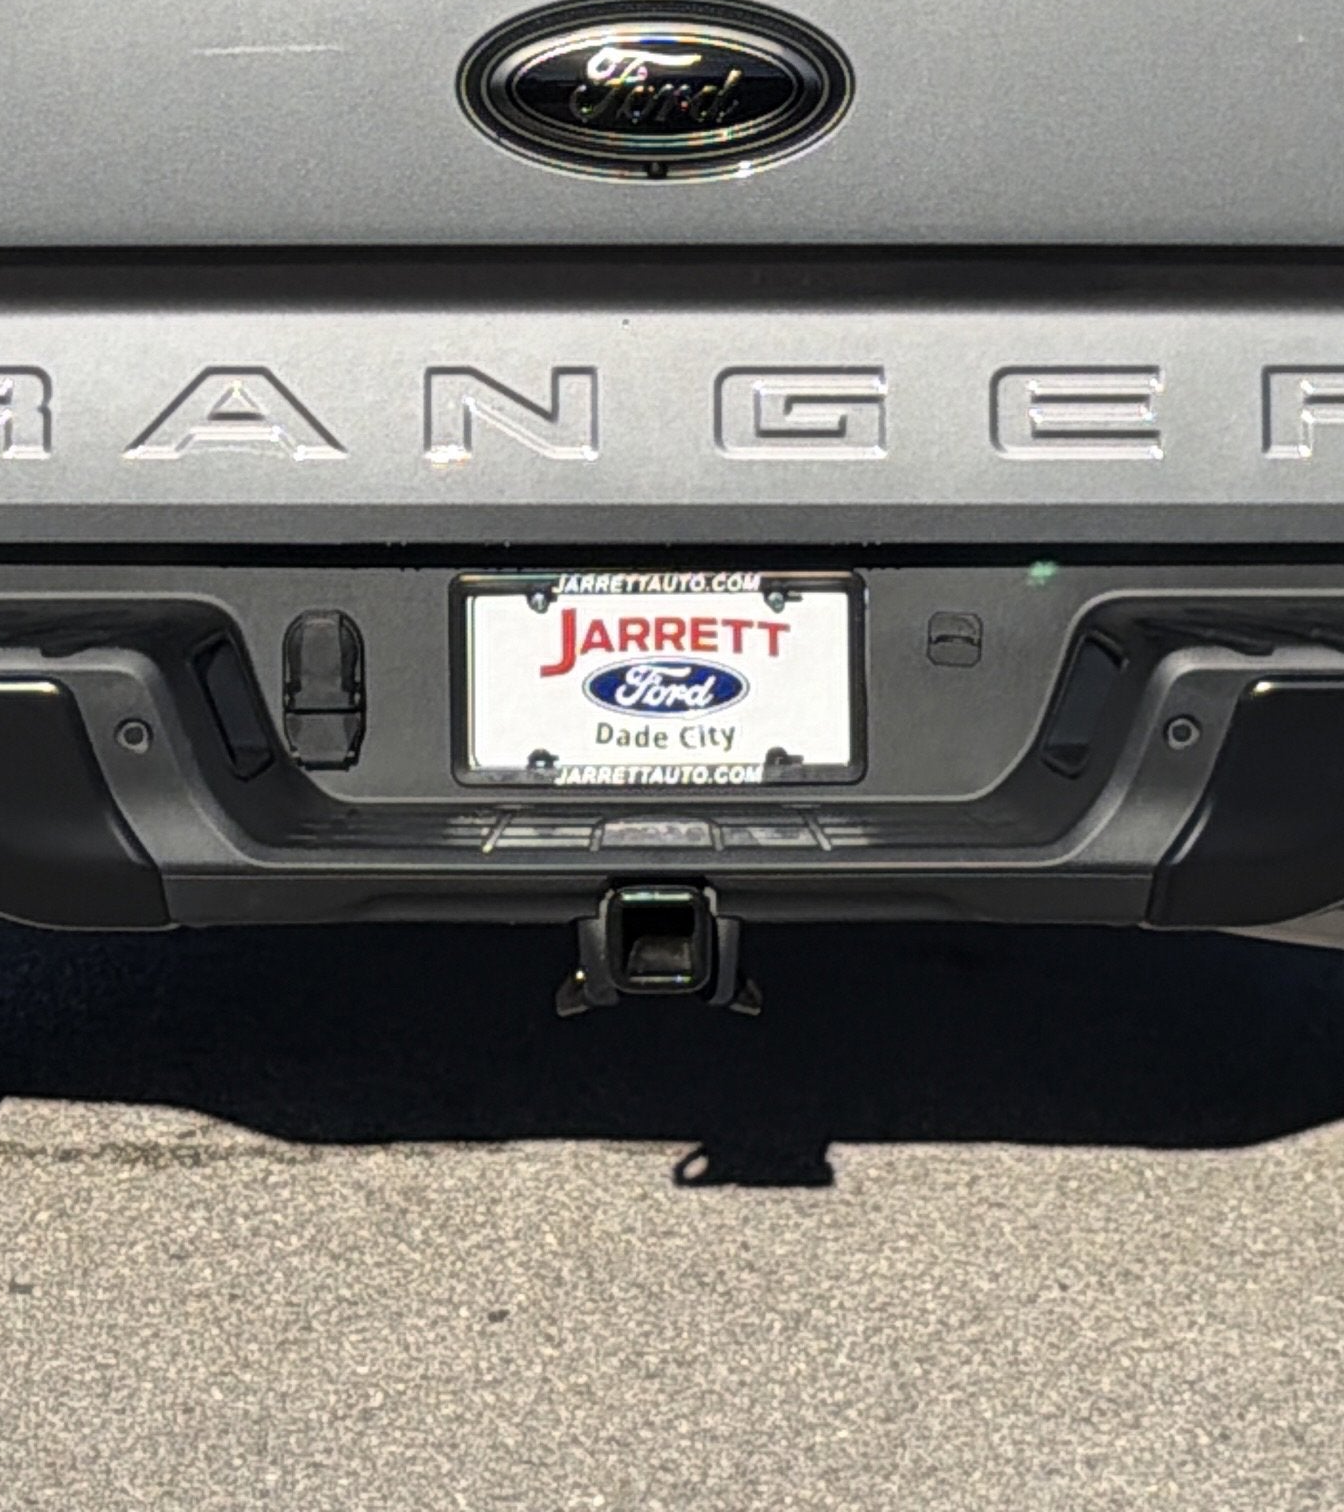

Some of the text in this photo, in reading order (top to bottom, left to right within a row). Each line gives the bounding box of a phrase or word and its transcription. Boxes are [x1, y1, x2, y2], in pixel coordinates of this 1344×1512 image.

[568, 46, 743, 123] Ford
[552, 573, 761, 593] JARRETTAUTO.COM
[540, 608, 791, 678] JARRETT
[614, 665, 716, 707] Ford
[595, 722, 736, 752] Dade City
[554, 765, 764, 785] JARRETTAUTO.COM
